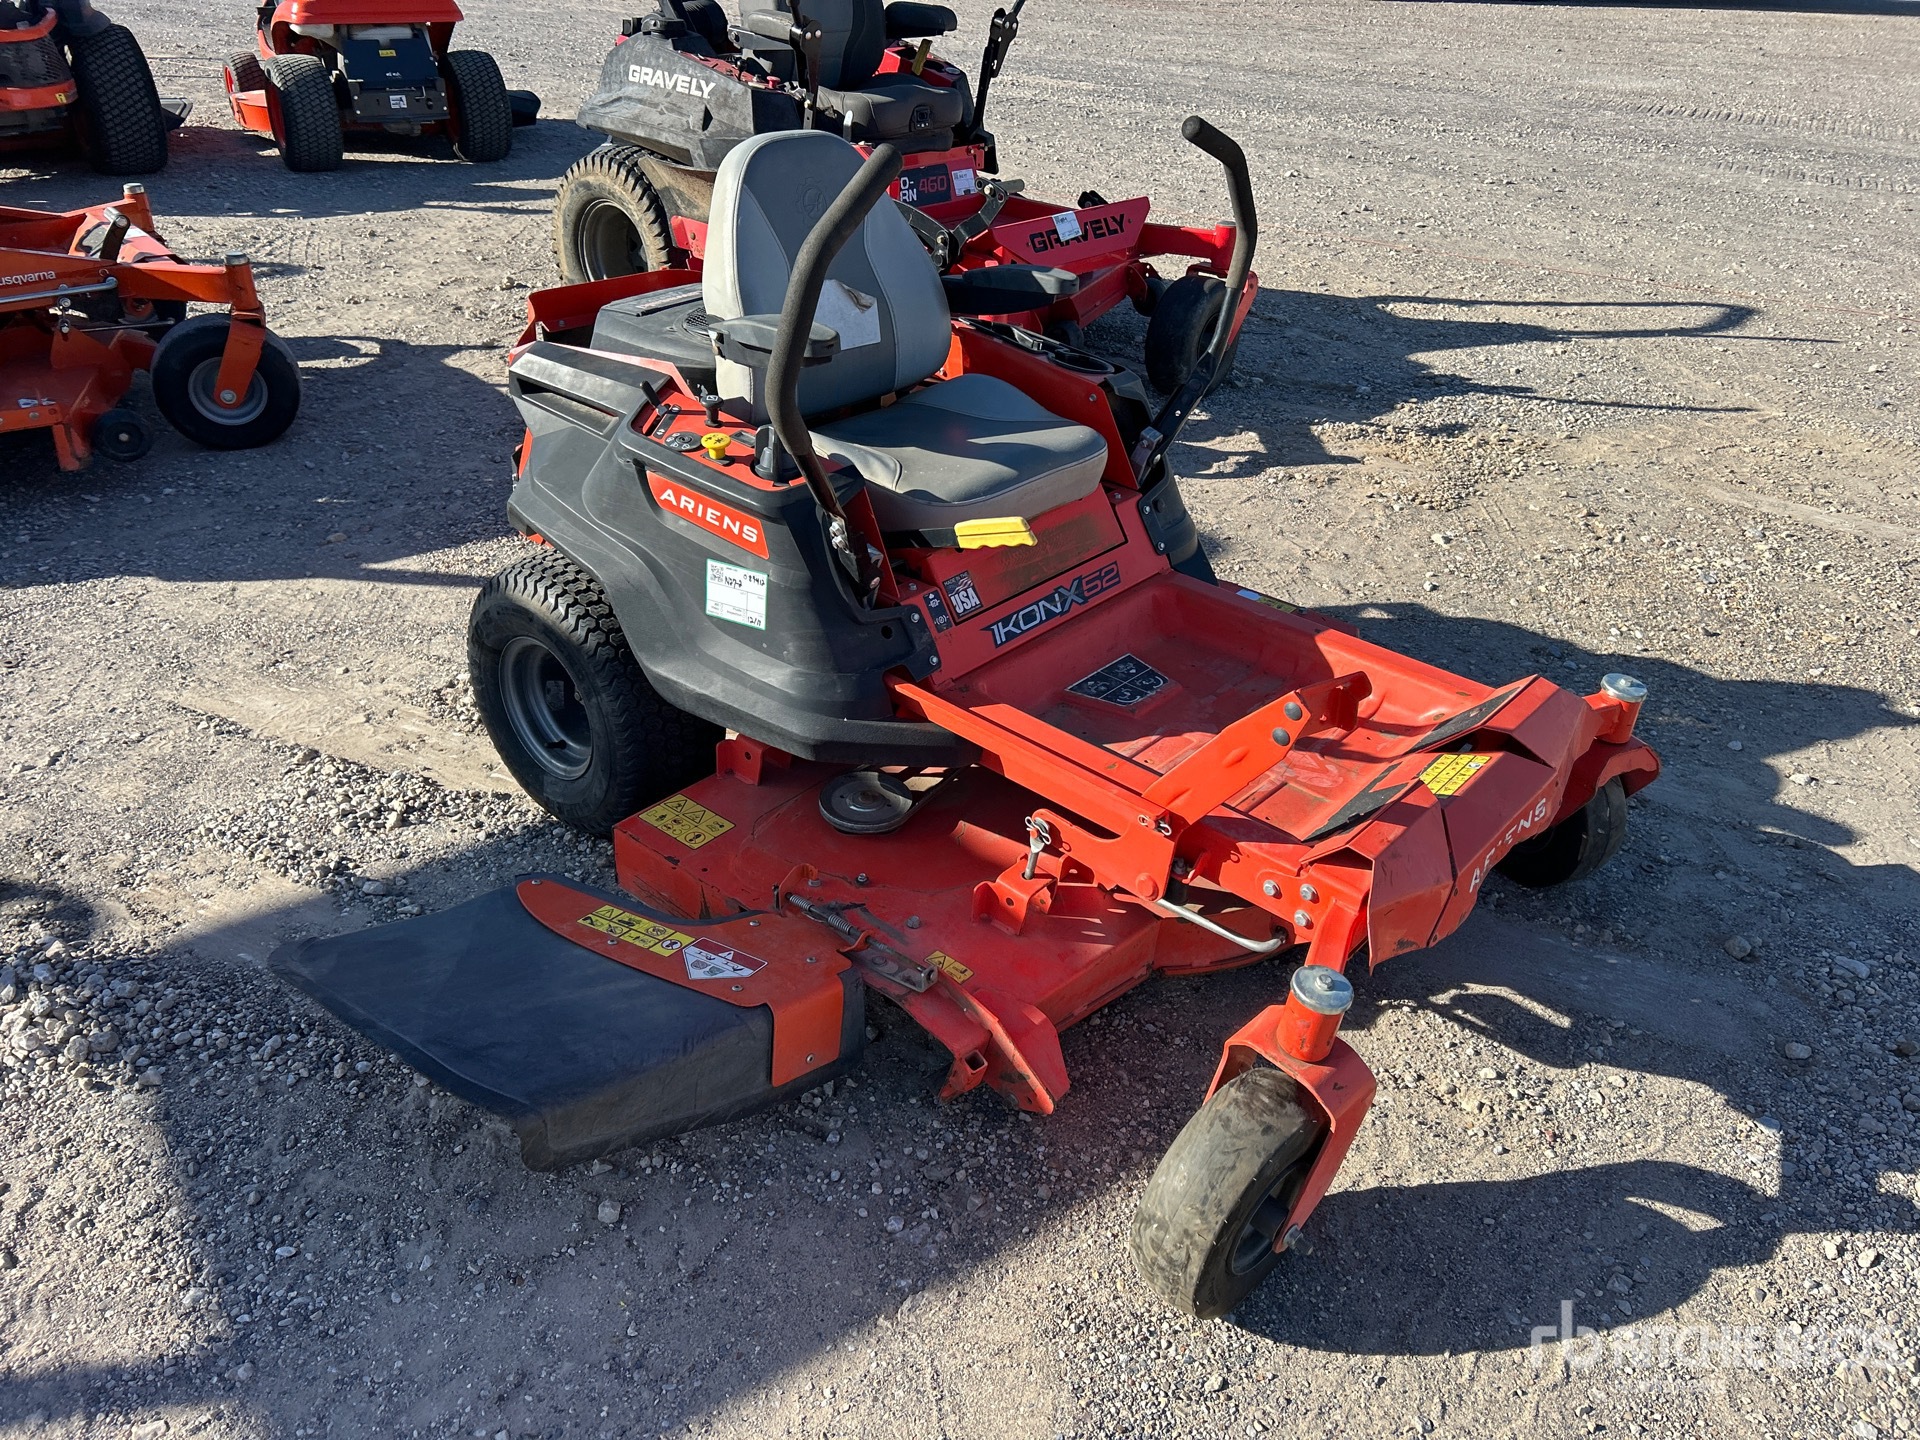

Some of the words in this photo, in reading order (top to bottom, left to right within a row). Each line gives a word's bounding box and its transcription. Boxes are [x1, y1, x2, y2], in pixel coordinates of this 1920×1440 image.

[628, 64, 716, 99] GRAVELY
[900, 188, 917, 203] RN
[919, 175, 947, 194] 460
[0, 270, 56, 285] usqvarna
[660, 488, 758, 543] ARIENS
[950, 587, 981, 614] USA
